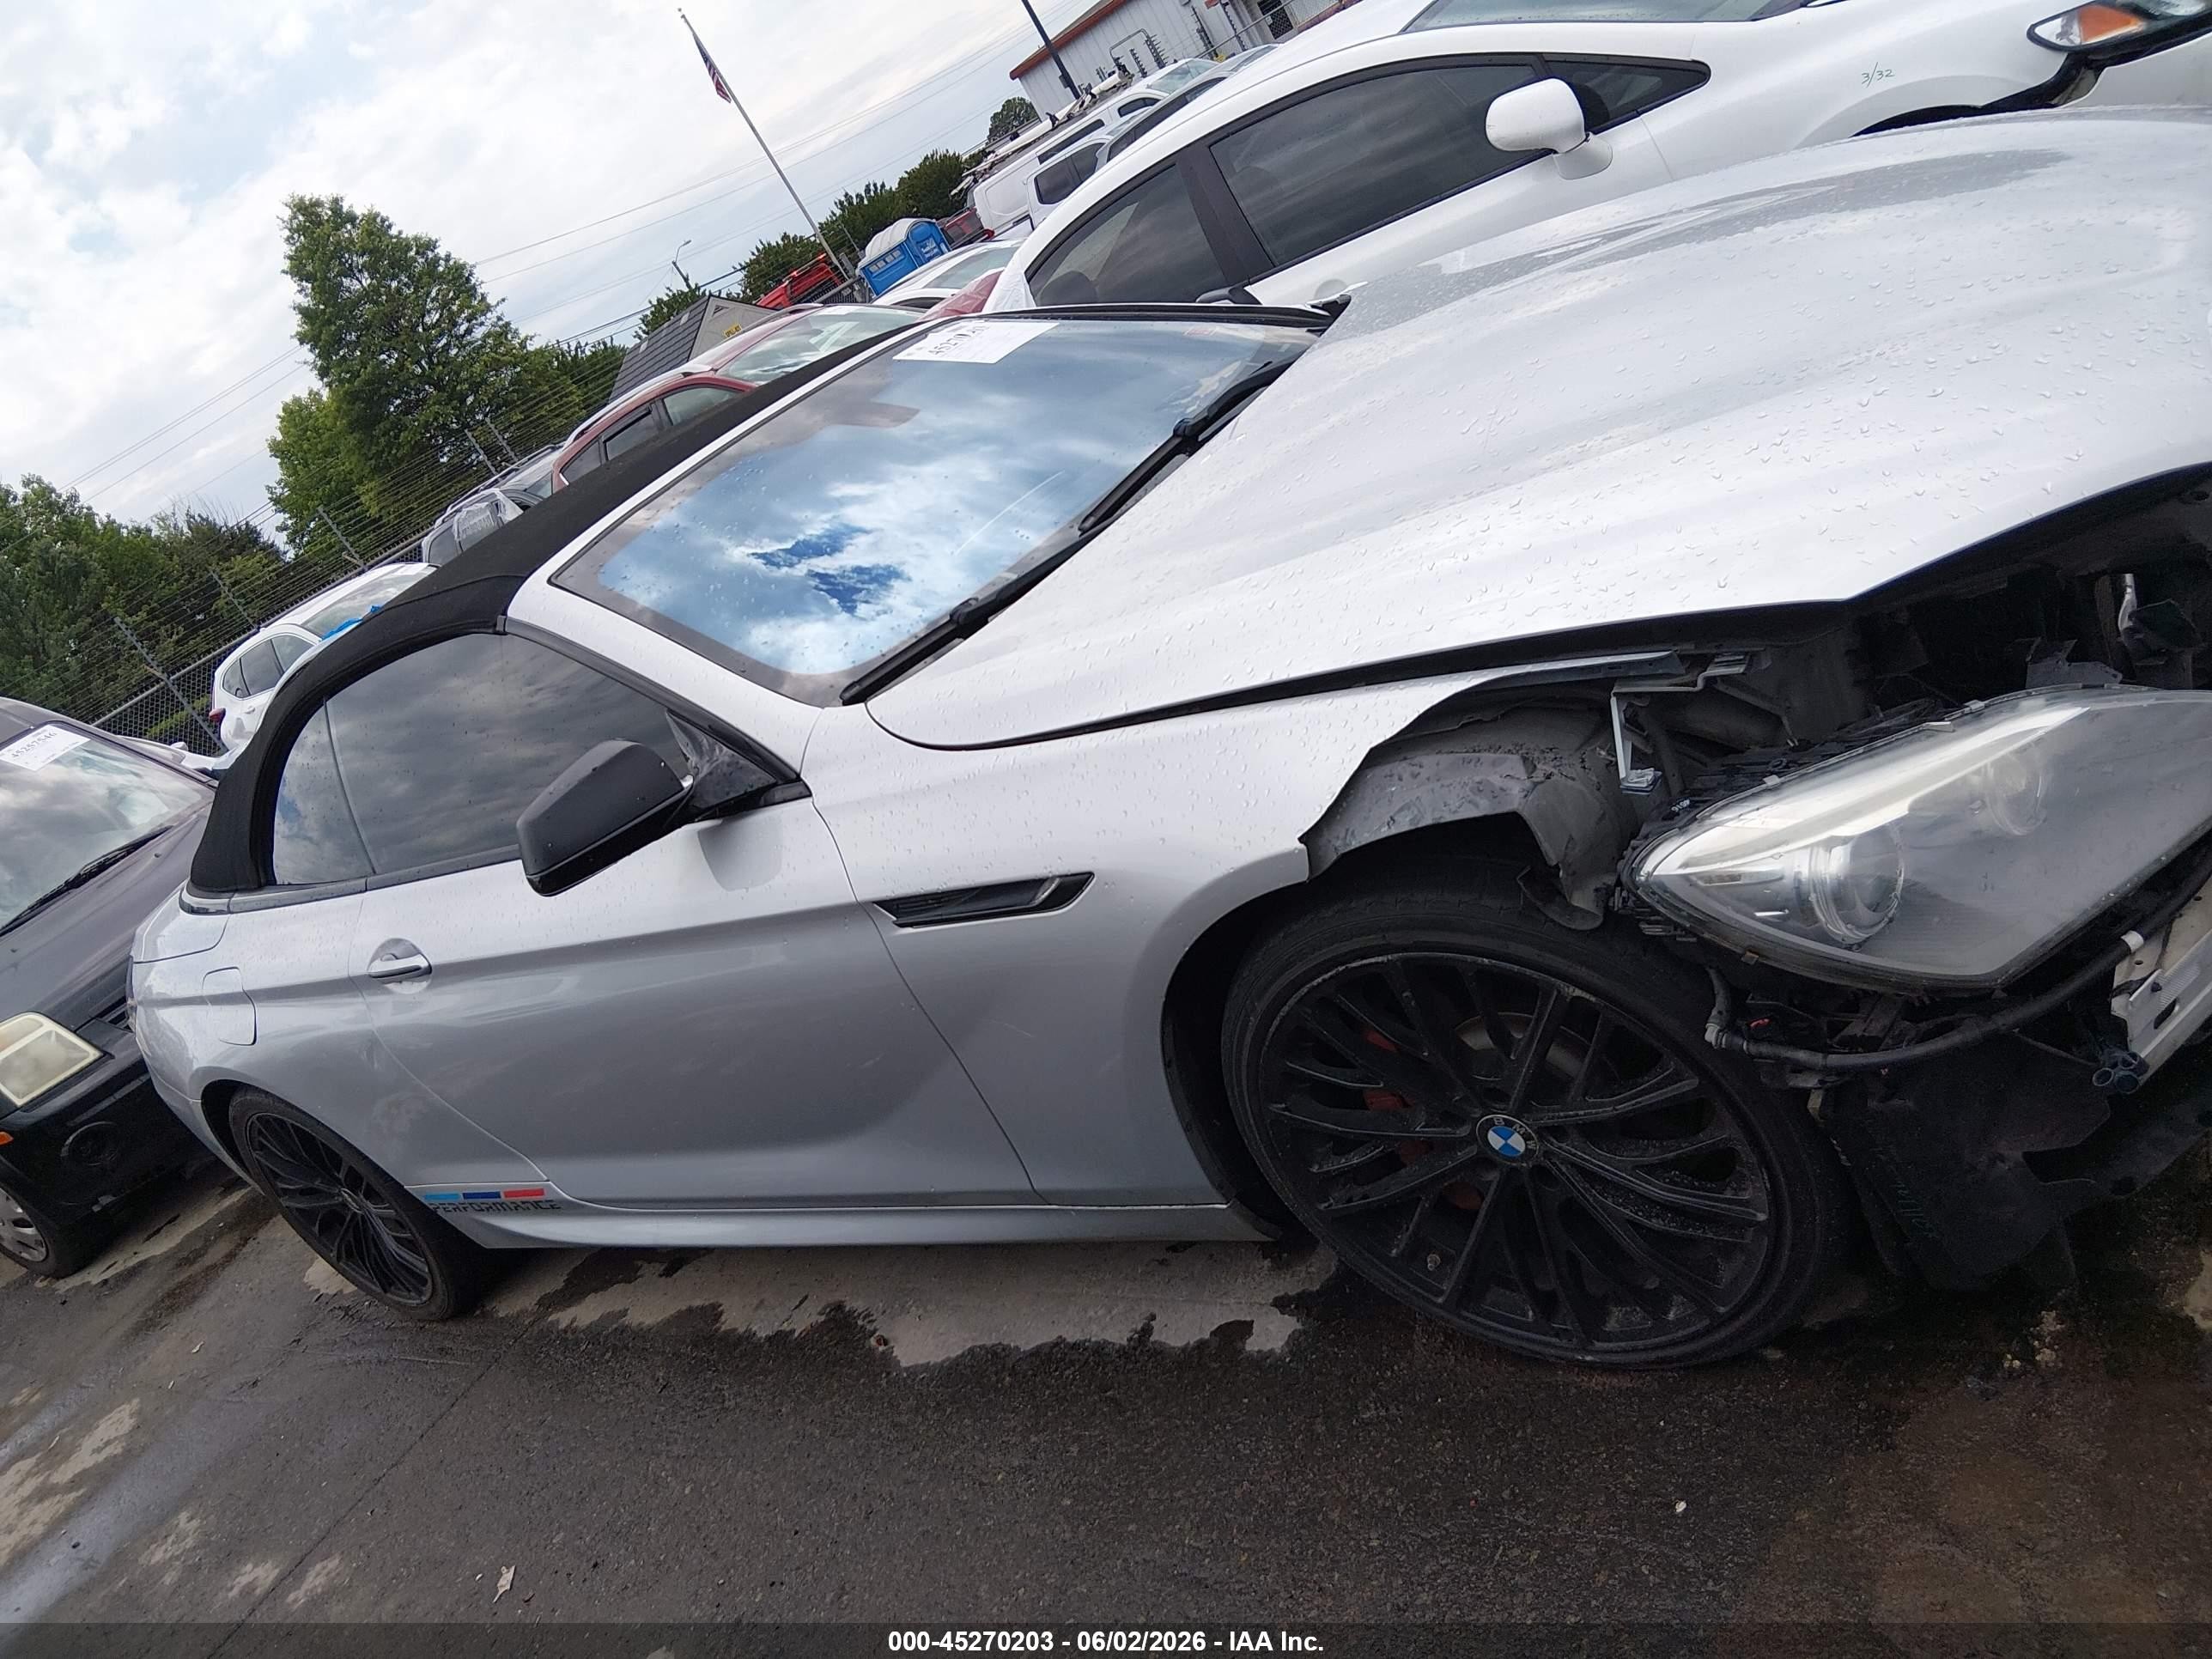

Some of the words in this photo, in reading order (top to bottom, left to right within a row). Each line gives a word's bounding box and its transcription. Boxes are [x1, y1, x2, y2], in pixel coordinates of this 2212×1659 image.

[1861, 61, 1895, 88] 3/32
[928, 325, 989, 355] 45270
[1493, 1117, 1536, 1151] BMW
[431, 1200, 562, 1213] PERFORMANCE
